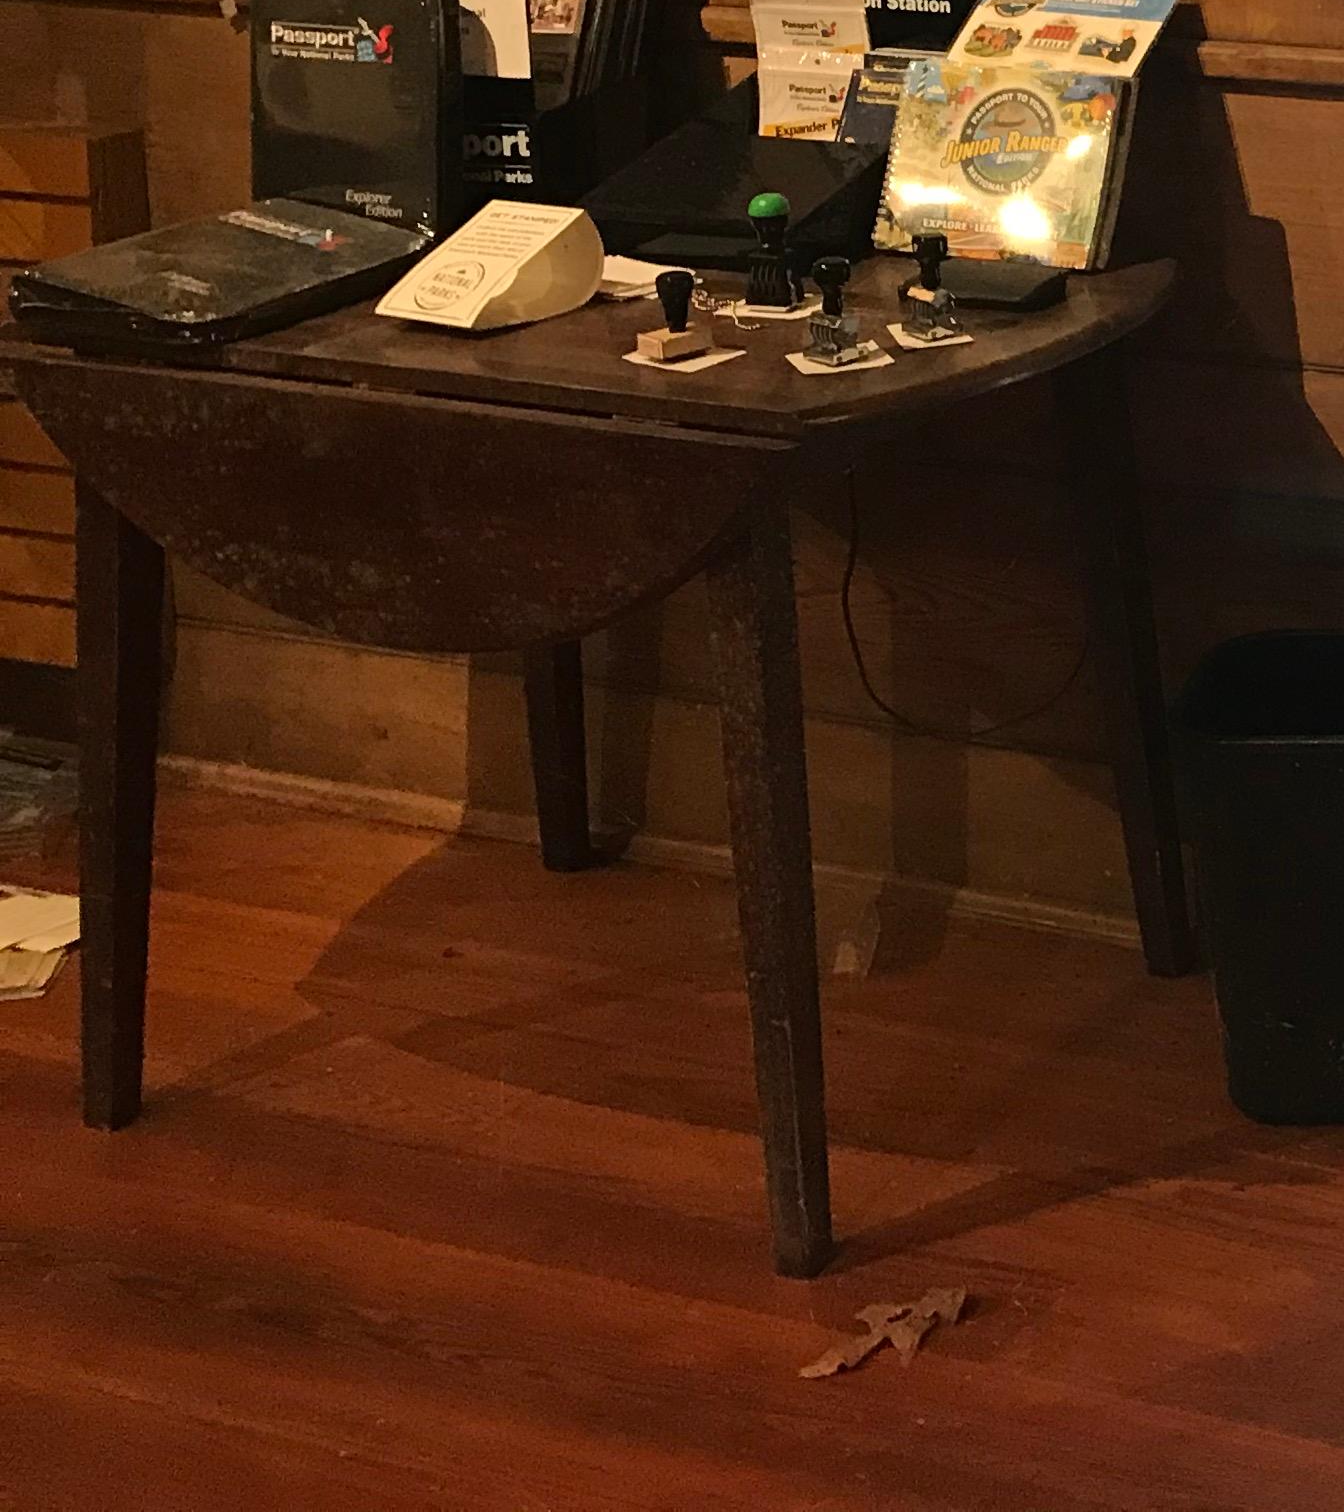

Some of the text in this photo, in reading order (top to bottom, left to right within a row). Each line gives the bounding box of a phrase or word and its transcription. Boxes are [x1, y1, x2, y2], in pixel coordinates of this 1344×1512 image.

[271, 25, 355, 48] Passport
[970, 93, 1049, 125] PASSPORT TO YOUR
[775, 122, 827, 138] Expander
[464, 130, 531, 161] port
[940, 130, 1068, 168] JUNIOR RANGER
[967, 165, 1006, 192] NATIONAL
[345, 189, 392, 205] Explorer
[366, 204, 402, 219] Edition
[923, 218, 967, 231] EXPLORE
